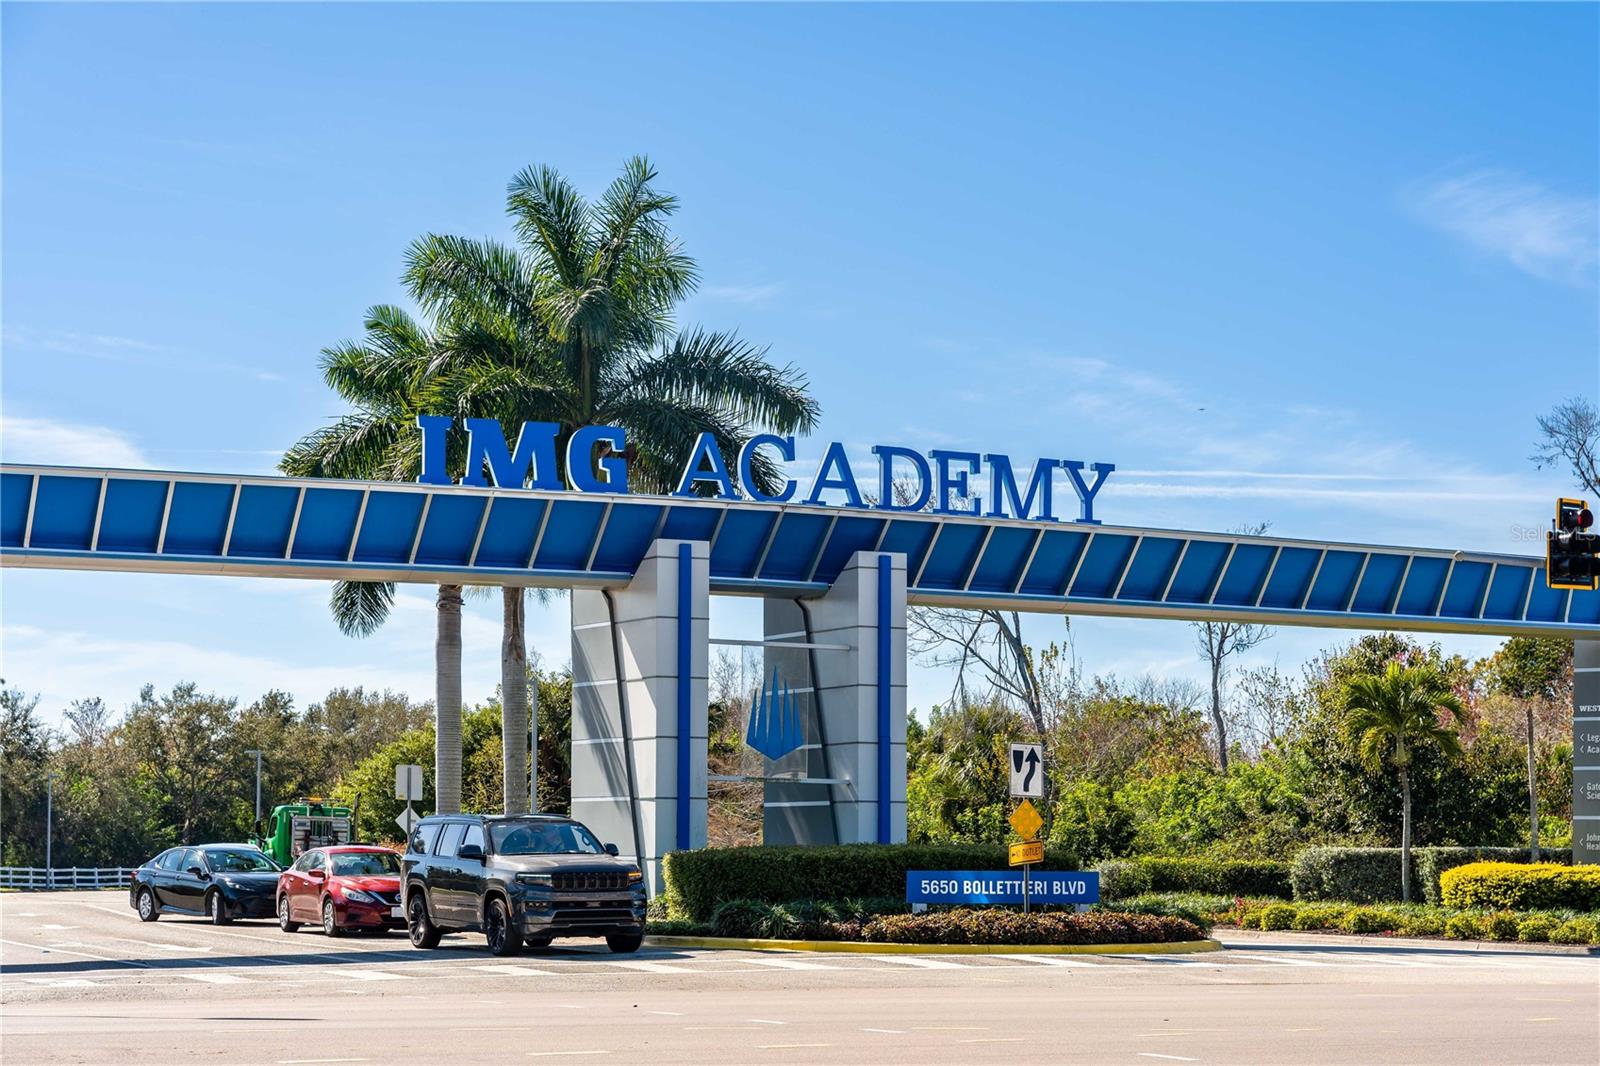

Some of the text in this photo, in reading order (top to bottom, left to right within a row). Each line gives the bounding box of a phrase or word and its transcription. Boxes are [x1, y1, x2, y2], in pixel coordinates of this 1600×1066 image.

[416, 415, 1116, 524] IMG ACADEMY
[1587, 733, 1600, 743] Leg
[921, 880, 1087, 895] 5650 BOLLETTIERI BLVD
